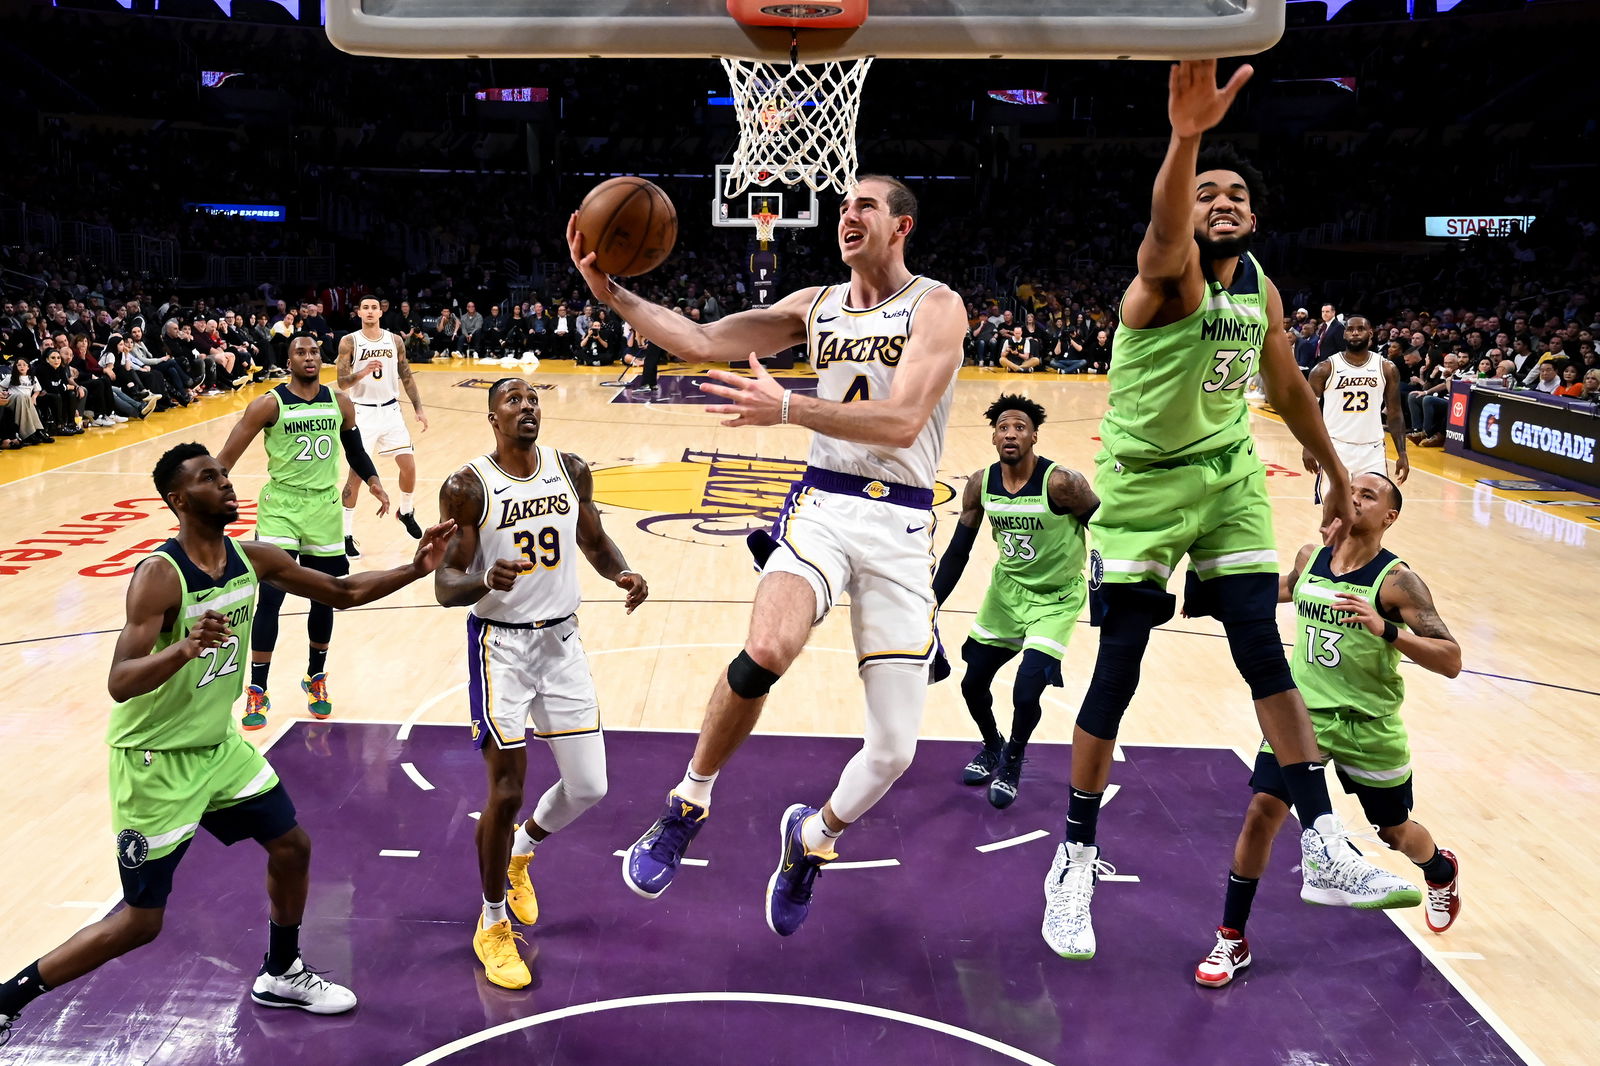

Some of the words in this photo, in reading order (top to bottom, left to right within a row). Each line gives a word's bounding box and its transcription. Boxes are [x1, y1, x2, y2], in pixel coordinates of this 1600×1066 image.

[1446, 219, 1515, 236] STAPL
[882, 308, 910, 319] wish
[359, 348, 393, 361] LAKERS
[816, 331, 907, 370] LAKERS
[1202, 348, 1256, 393] 32
[1335, 375, 1378, 390] LAKERS
[1342, 390, 1369, 413] 23
[283, 418, 337, 434] MINNESOTA
[1445, 430, 1465, 442] TOYOTA
[294, 434, 333, 461] 20
[1511, 421, 1596, 463] GATORADE
[542, 475, 561, 484] wish
[496, 493, 571, 531] LAKERS
[988, 515, 1045, 530] INNESOTA
[513, 526, 562, 576] 39
[998, 530, 1037, 561] 33
[1350, 586, 1368, 595] fitbit
[1305, 624, 1344, 668] 13
[196, 634, 240, 688] 22
